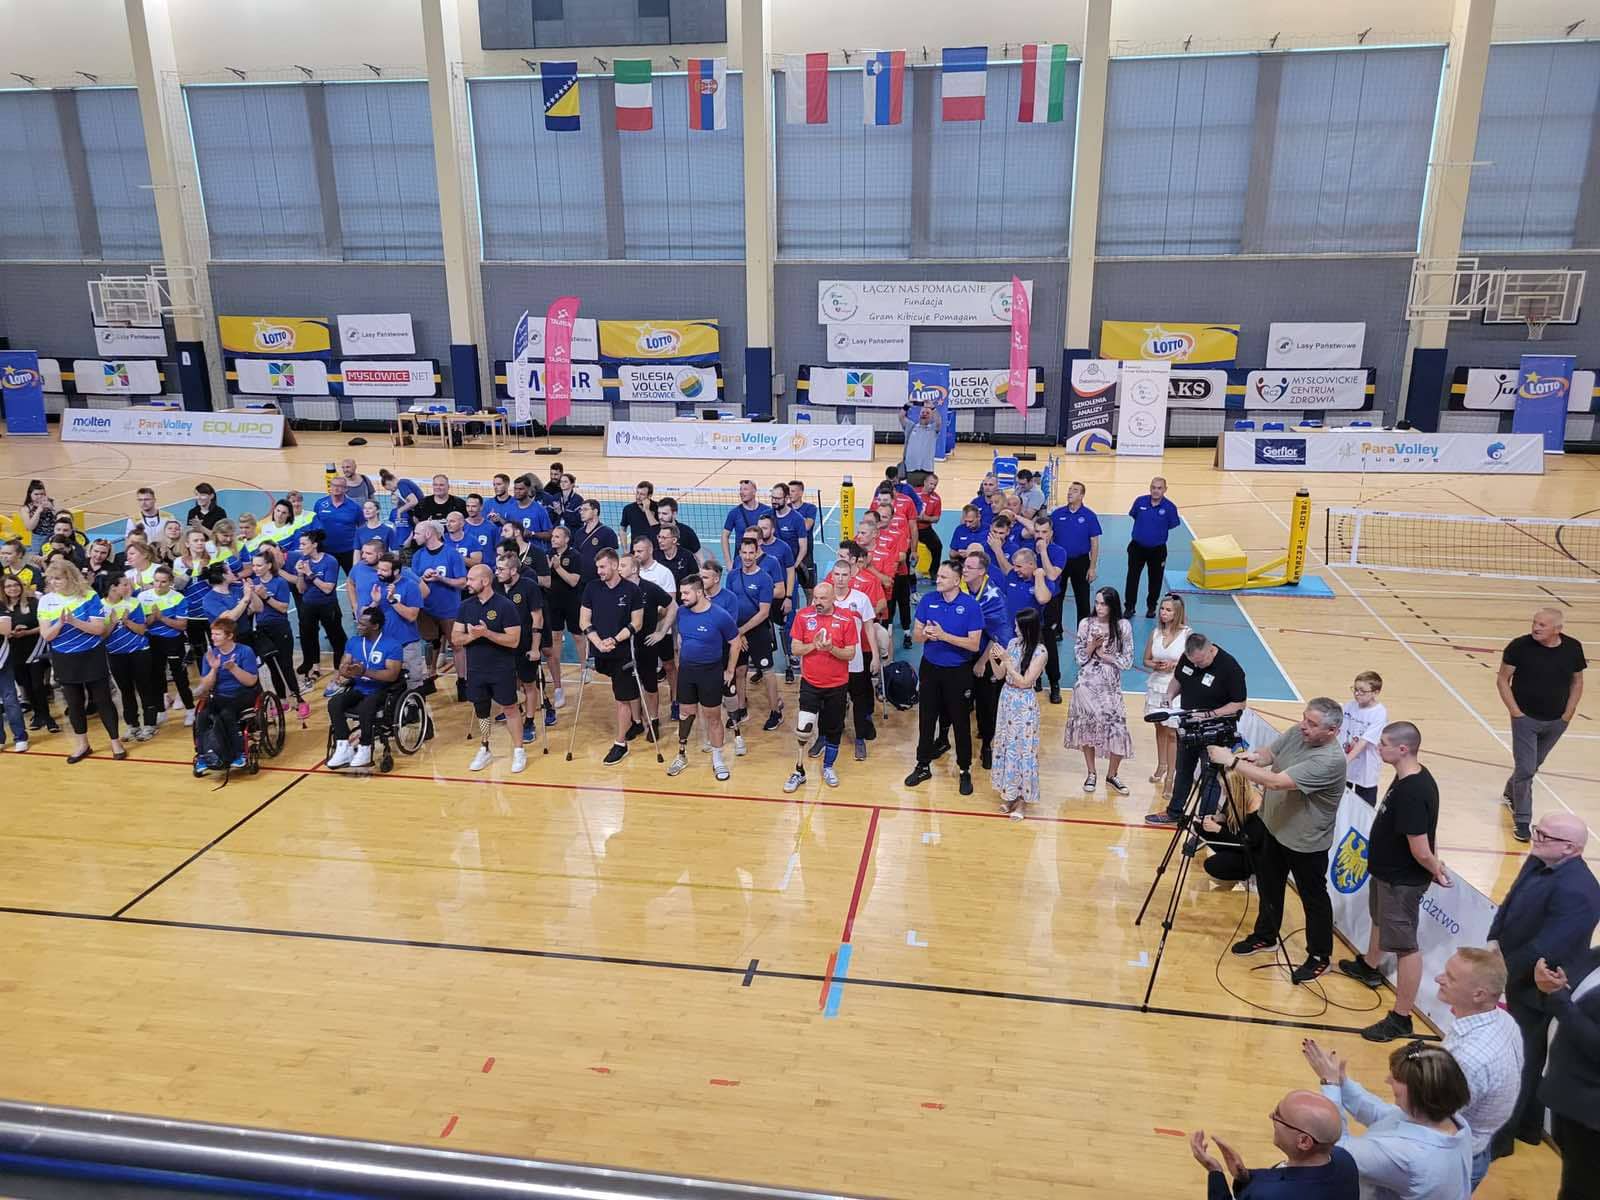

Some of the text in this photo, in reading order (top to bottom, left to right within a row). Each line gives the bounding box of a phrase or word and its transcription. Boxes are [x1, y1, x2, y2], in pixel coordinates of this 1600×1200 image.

[862, 284, 986, 294] ŁĄCZY NAS POMAGANIE
[903, 296, 943, 307] Fundacja
[869, 312, 978, 323] Gram Kibicuje Pomagam
[262, 332, 287, 345] LOTTO
[646, 335, 672, 349] LOTTO
[1153, 339, 1183, 354] LOTTO
[9, 373, 32, 385] LOTTO
[631, 372, 673, 381] SILESIA
[951, 377, 989, 386] ILESIA
[1291, 376, 1358, 385] MYSŁOWICKIE
[632, 381, 674, 391] VOLLEY
[1290, 386, 1335, 394] CENTRUM
[1529, 381, 1560, 394] LOTTO
[916, 389, 940, 401] LOTTO
[951, 388, 988, 397] OLLEY
[950, 397, 990, 405] YSŁOWICE
[1073, 397, 1107, 409] SZKOLENIA
[1289, 396, 1336, 404] ZDROWIA
[1077, 405, 1103, 417] ANALIZY
[73, 415, 111, 427] molten
[139, 418, 193, 431] ParaVolley
[203, 420, 273, 434] EQUIPO
[1072, 417, 1109, 431] DATAVOLLEY
[712, 432, 778, 446] ParaVolley
[812, 436, 865, 449] sporteq
[1263, 445, 1298, 457] Gerflor
[1361, 442, 1439, 457] ParaVolley
